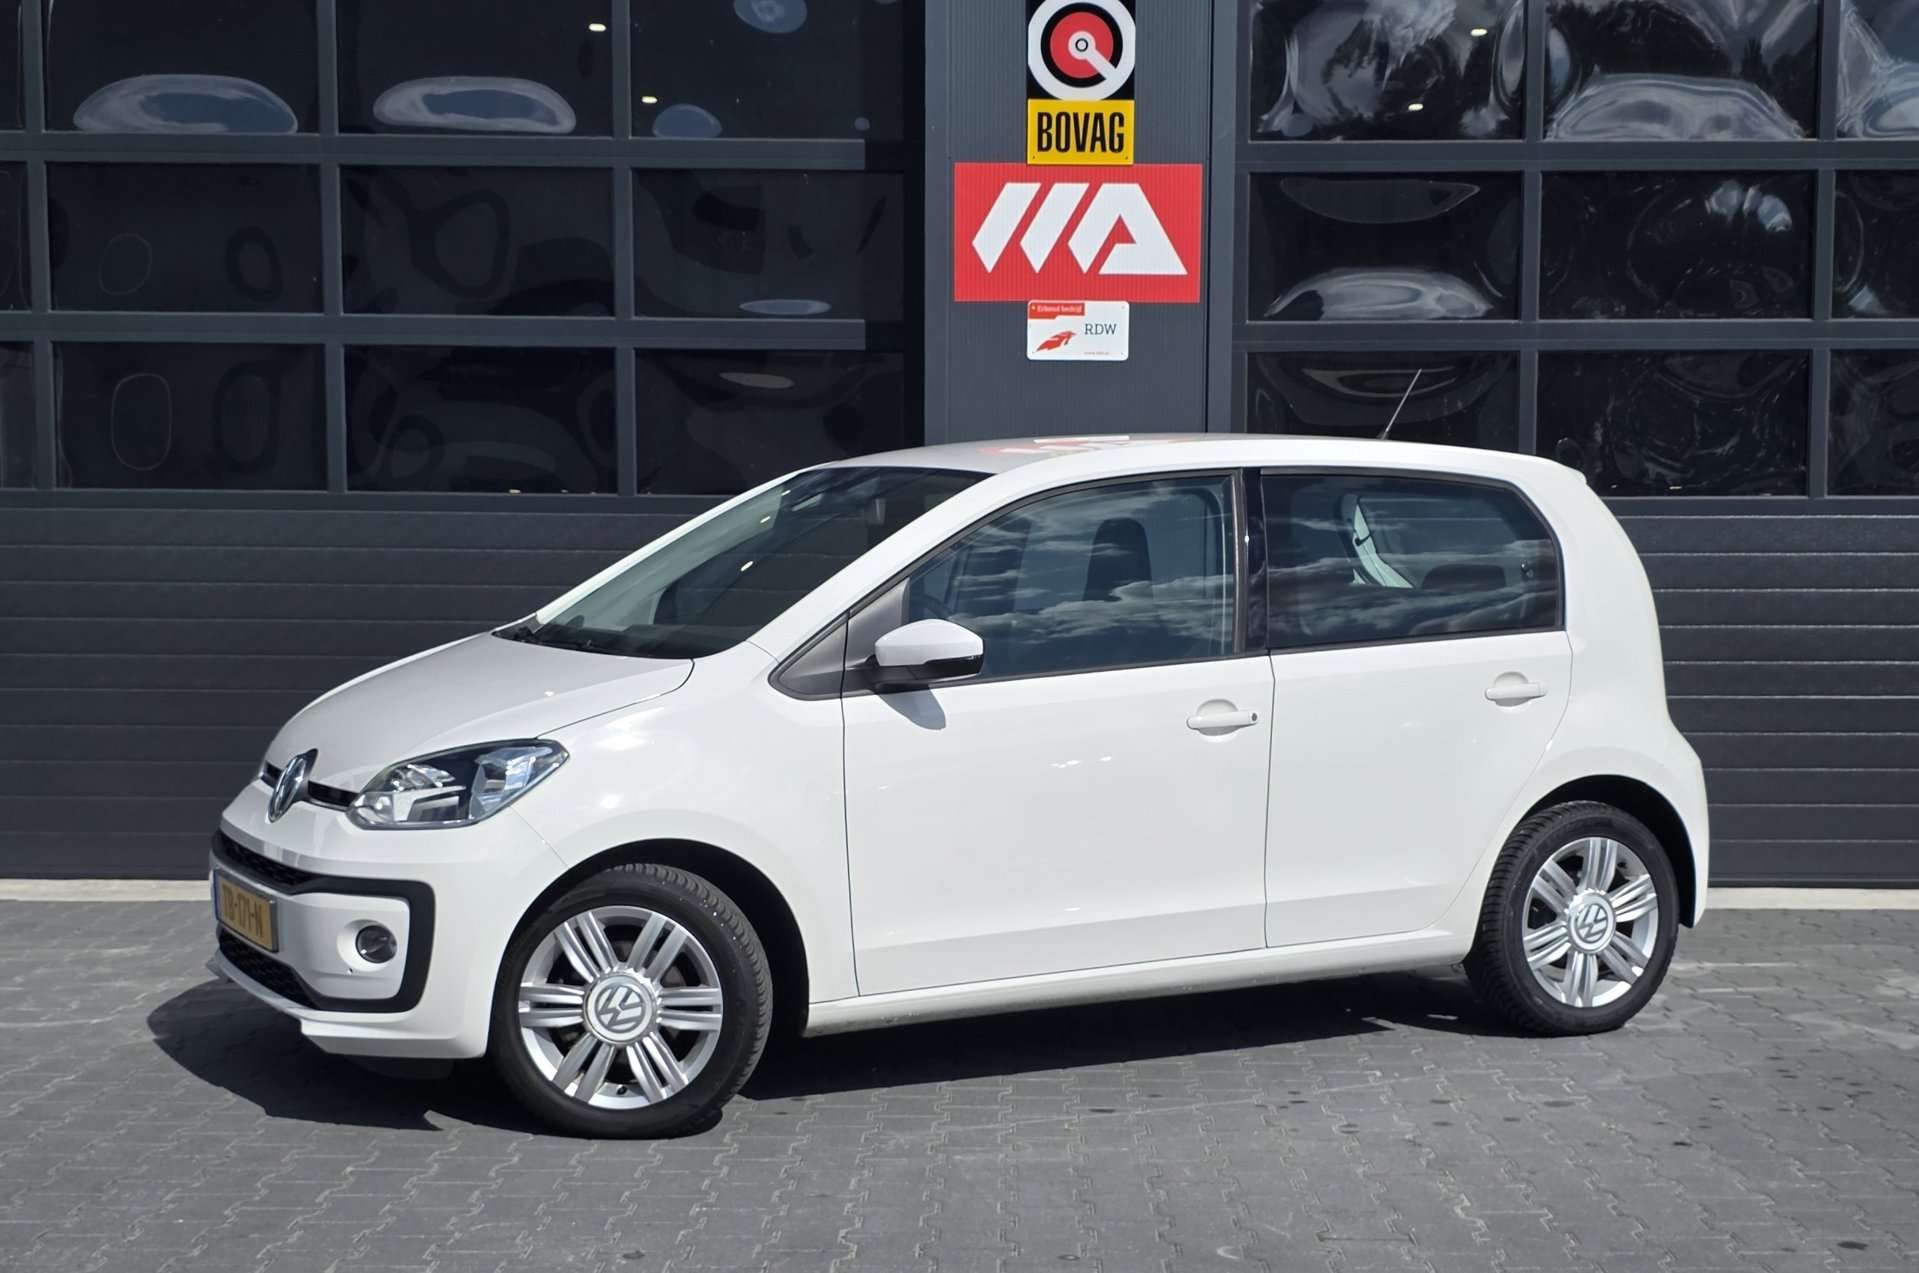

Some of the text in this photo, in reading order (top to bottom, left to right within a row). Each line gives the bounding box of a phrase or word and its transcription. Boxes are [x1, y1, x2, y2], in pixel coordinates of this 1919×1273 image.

[1037, 111, 1125, 153] BOVAG
[1084, 323, 1117, 336] RDW
[594, 983, 646, 1034] VW
